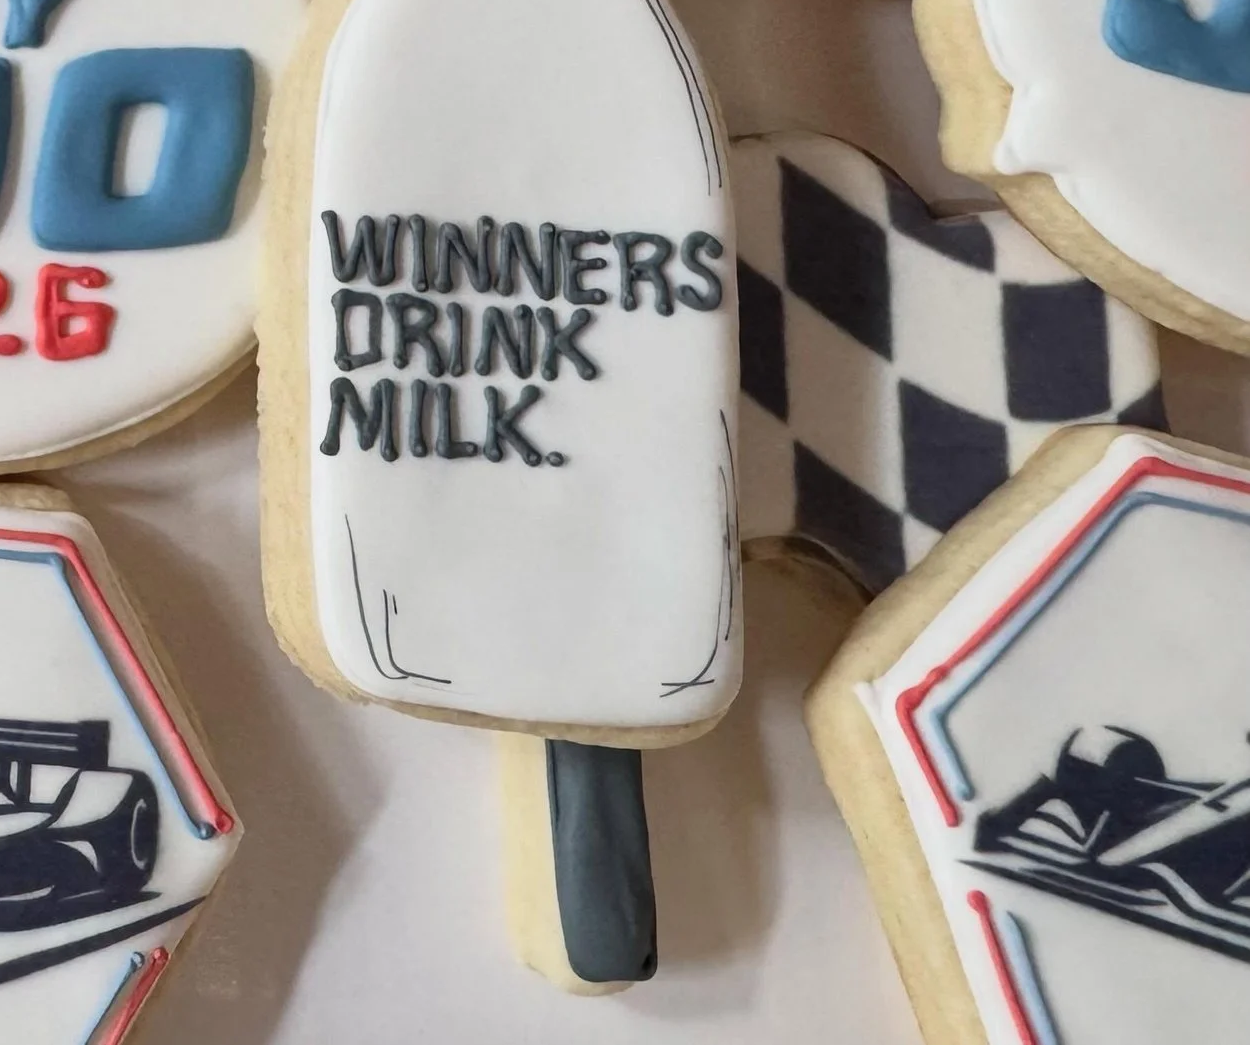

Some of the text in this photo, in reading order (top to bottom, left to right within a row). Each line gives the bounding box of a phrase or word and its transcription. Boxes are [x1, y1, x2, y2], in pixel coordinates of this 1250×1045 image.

[321, 210, 725, 317] WINNERS
[331, 288, 597, 381] DRINK
[320, 377, 566, 467] MILK.
